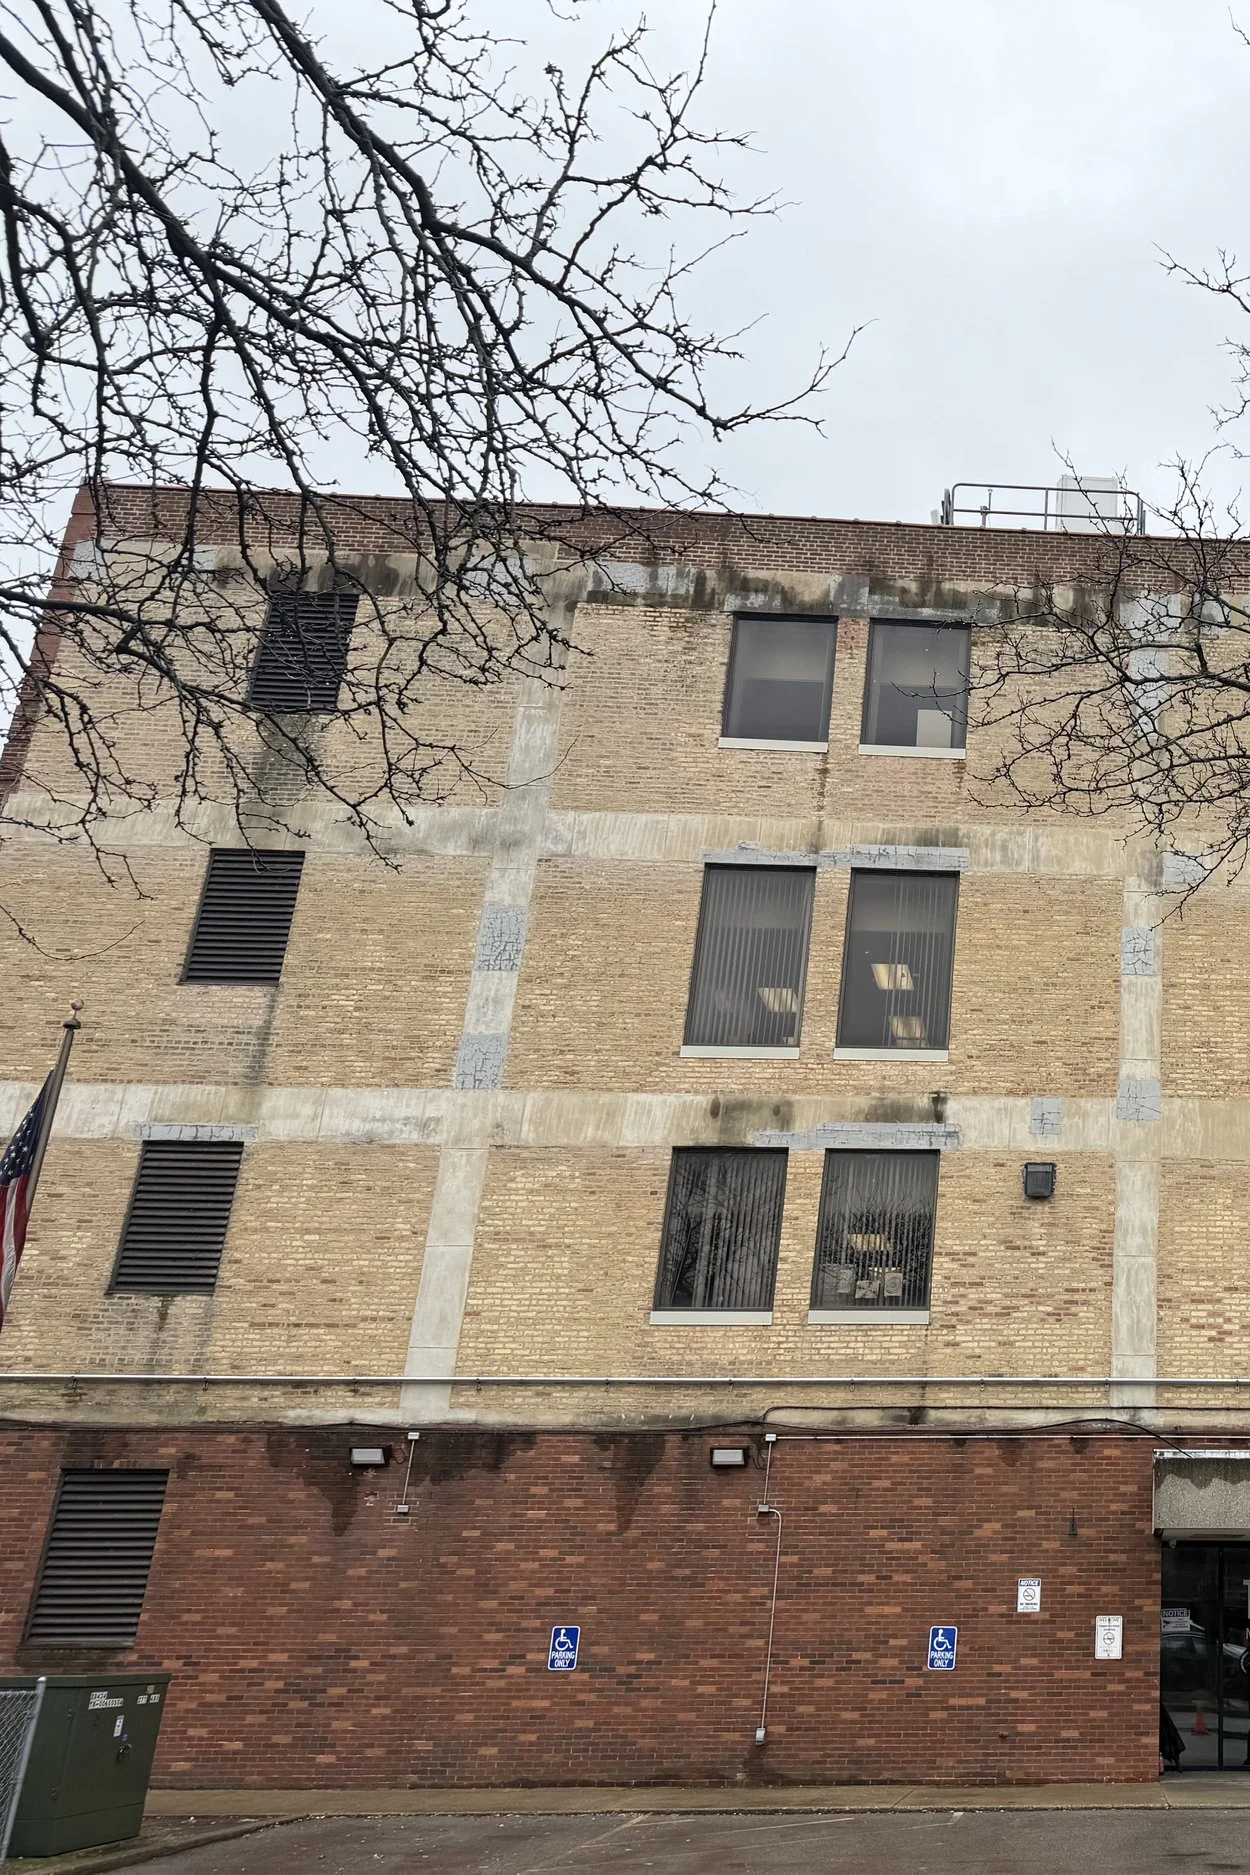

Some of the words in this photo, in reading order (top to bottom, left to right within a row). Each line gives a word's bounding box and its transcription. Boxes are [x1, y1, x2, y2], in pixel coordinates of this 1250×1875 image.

[551, 1651, 575, 1659] PARKING
[930, 1651, 954, 1659] PARKING
[554, 1659, 570, 1667] ONLY
[933, 1659, 949, 1667] ONLY
